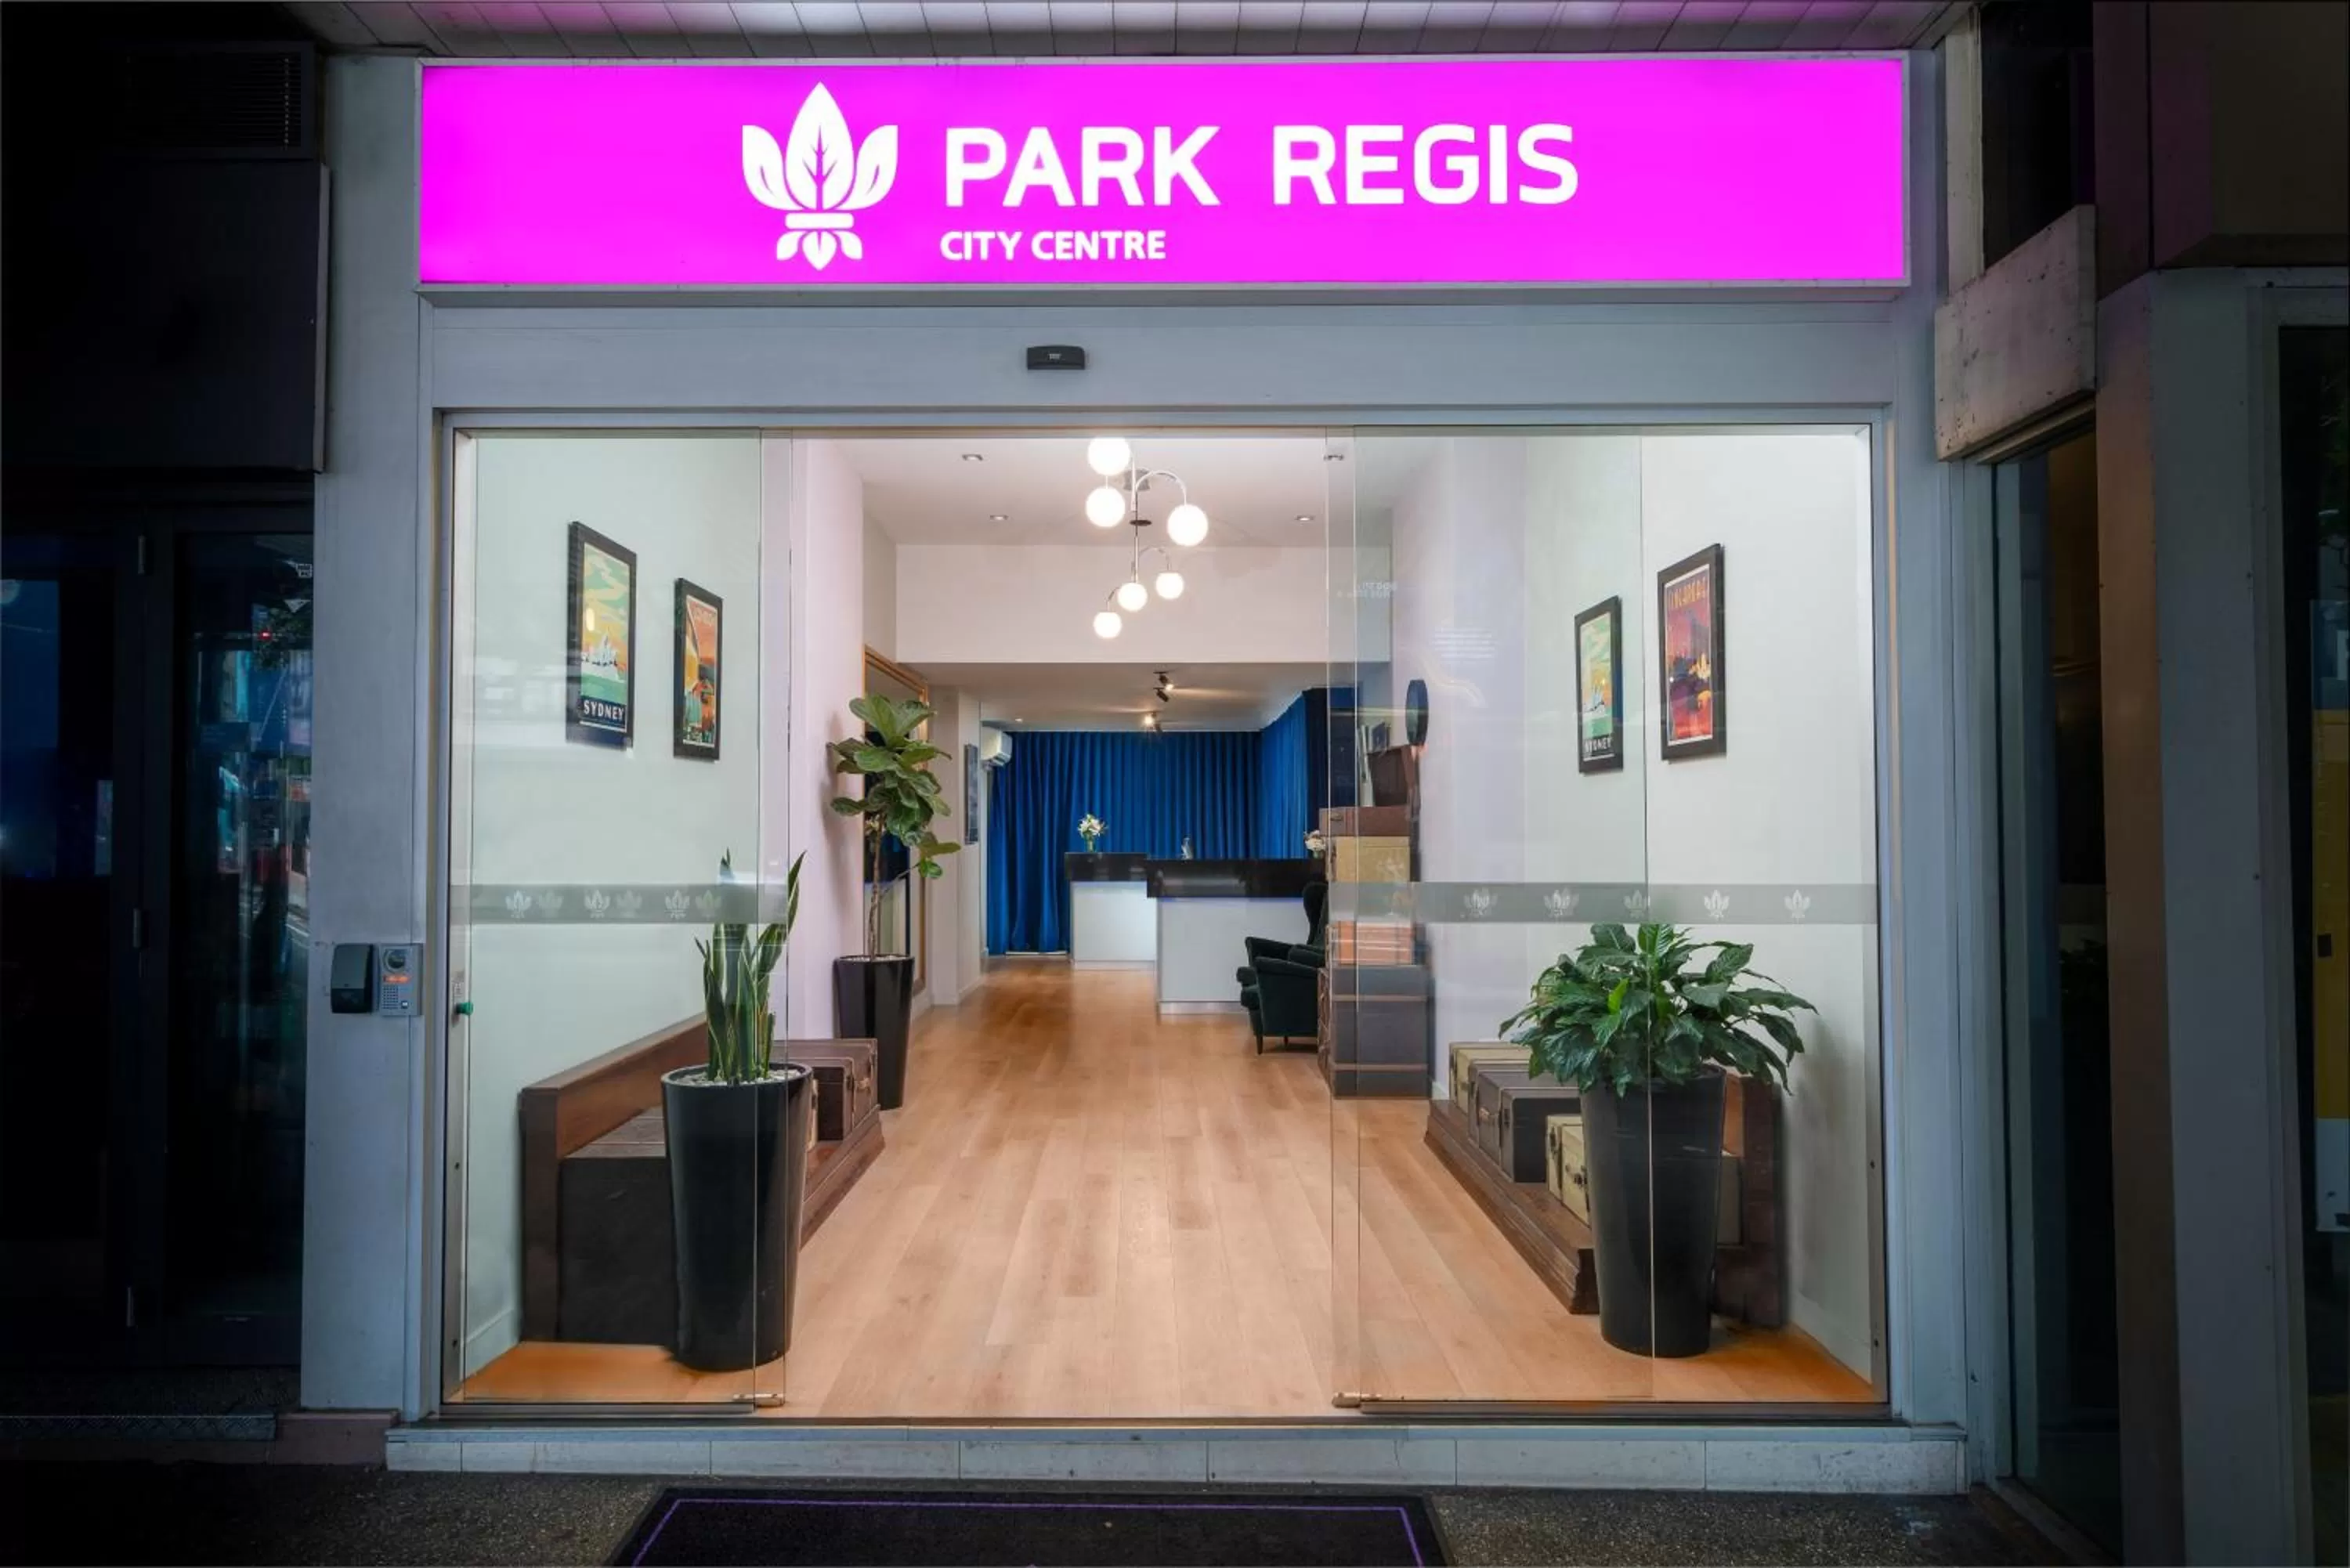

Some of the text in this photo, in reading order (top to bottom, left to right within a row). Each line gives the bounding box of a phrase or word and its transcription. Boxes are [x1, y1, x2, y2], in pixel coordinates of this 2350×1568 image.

[946, 124, 1578, 207] PARK REGIS
[941, 231, 1166, 260] CITY CENTRE
[584, 699, 624, 720] SYDNEY
